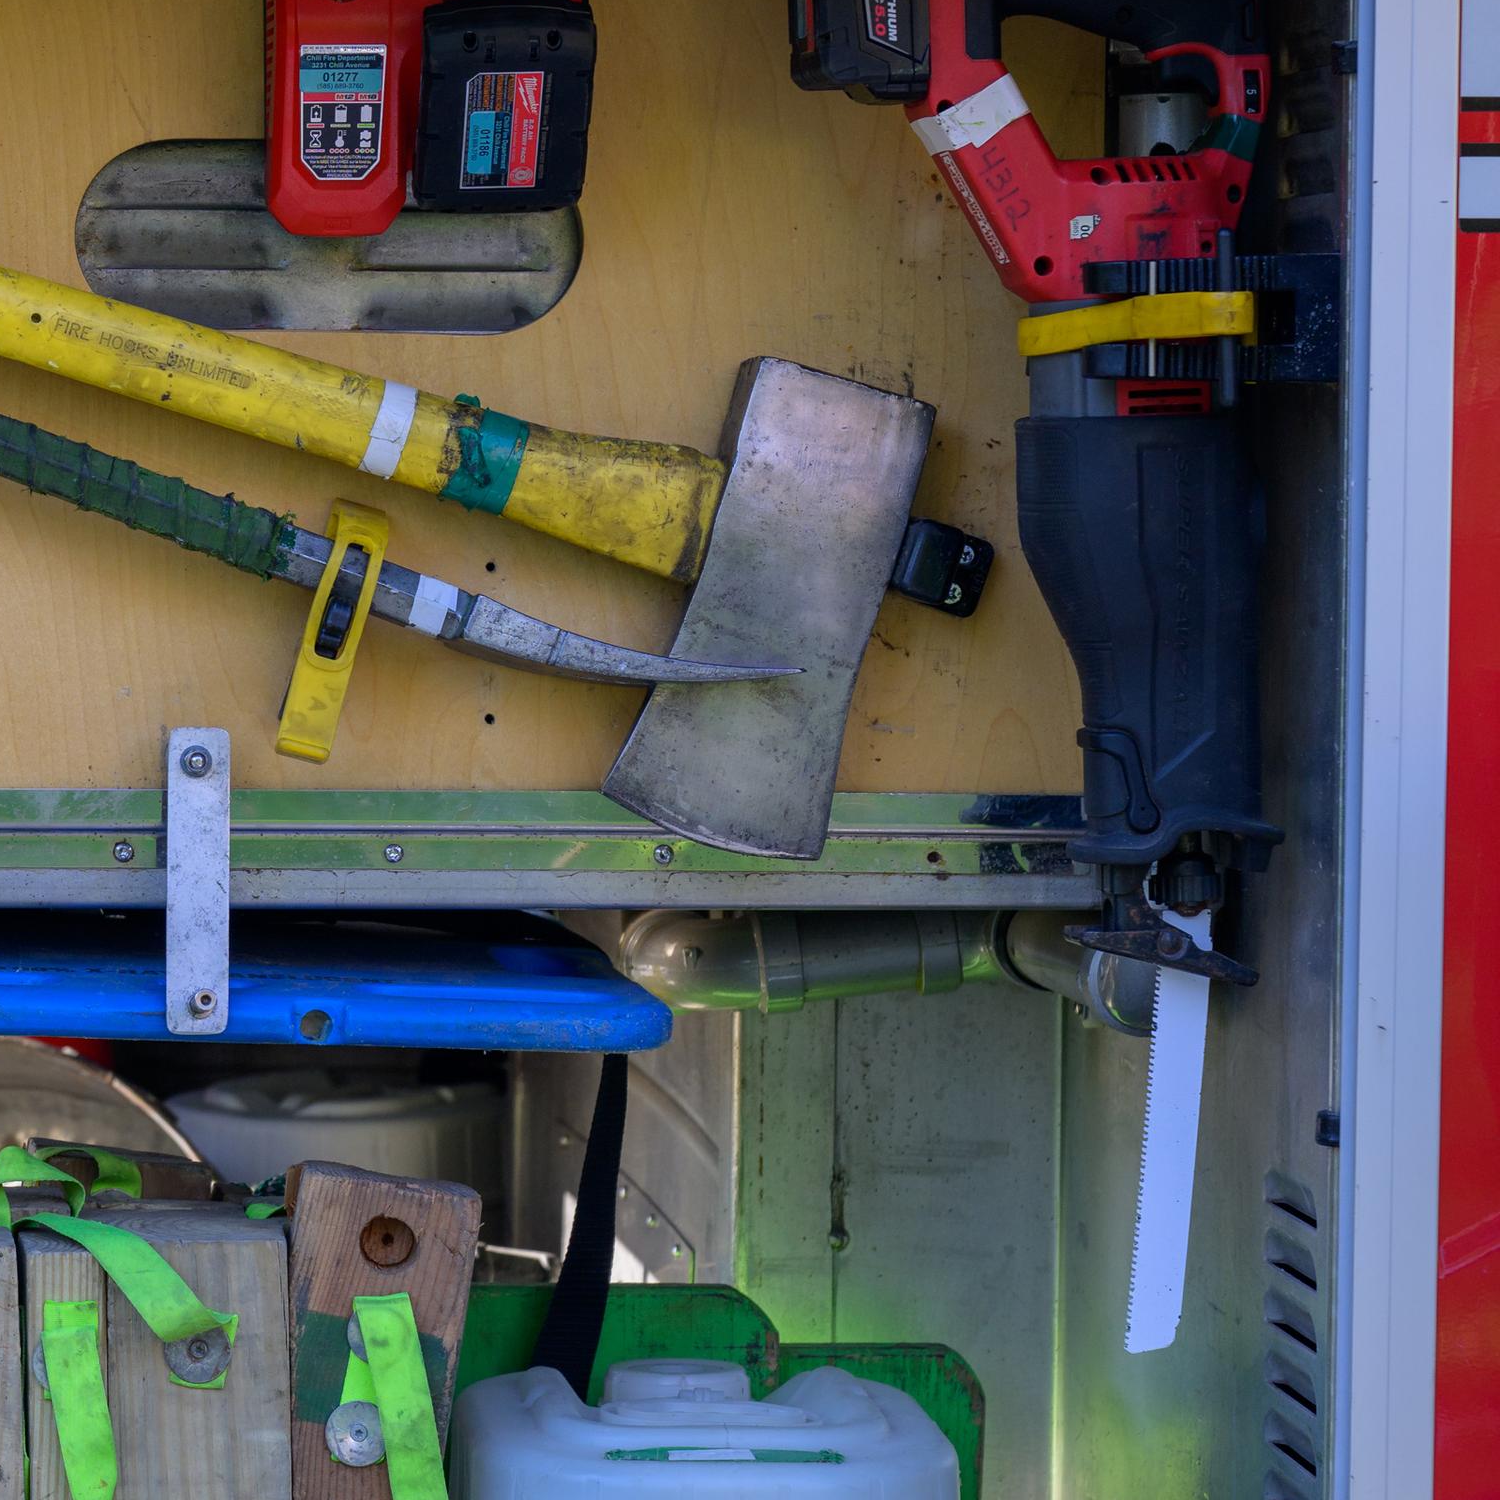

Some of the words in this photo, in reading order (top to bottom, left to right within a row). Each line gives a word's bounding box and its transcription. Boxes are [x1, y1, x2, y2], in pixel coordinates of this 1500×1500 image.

[323, 72, 358, 82] 01277
[1246, 88, 1257, 96] 5
[479, 129, 491, 157] 01186
[978, 146, 1032, 231] 4312
[53, 317, 92, 342] FIRE
[98, 331, 159, 361] HOOKS
